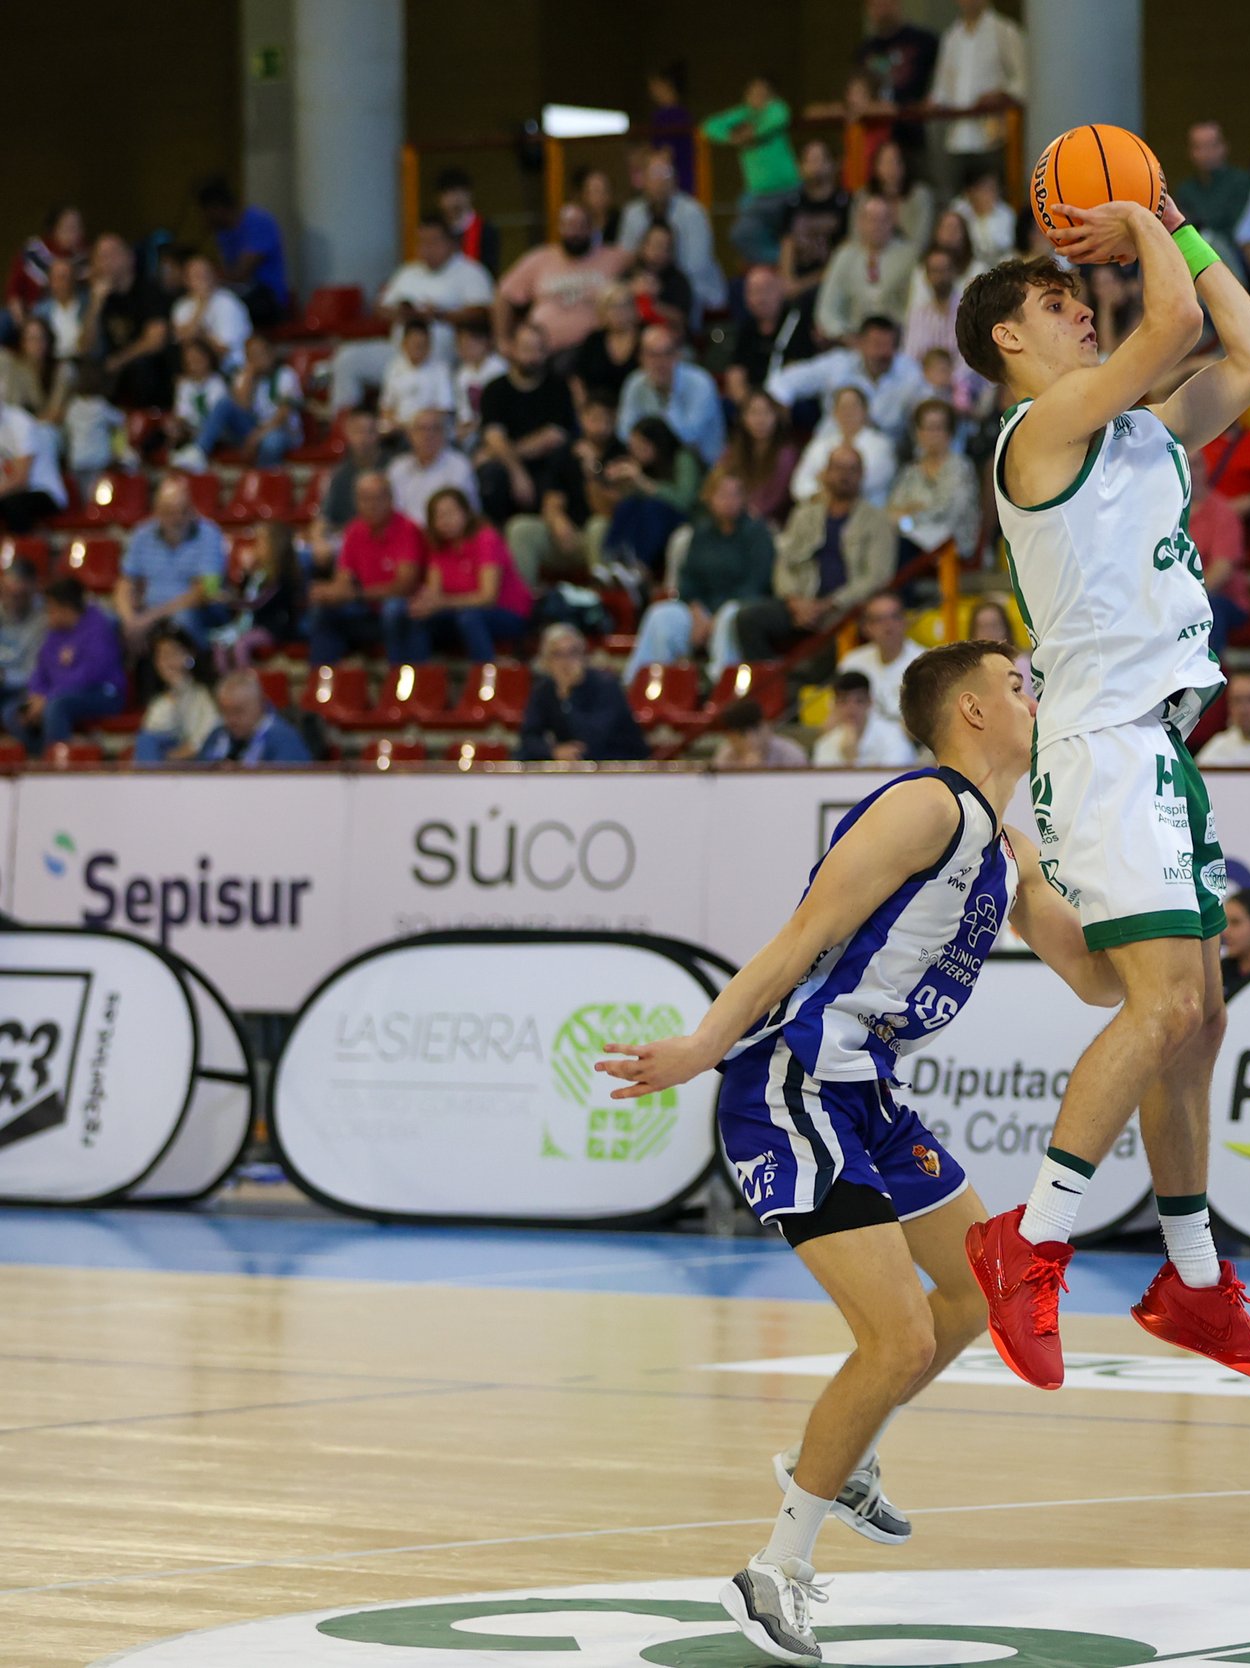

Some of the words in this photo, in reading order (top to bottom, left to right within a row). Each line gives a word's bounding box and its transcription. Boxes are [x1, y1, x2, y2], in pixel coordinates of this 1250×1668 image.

[1154, 800, 1188, 816] Hospit
[82, 852, 312, 944] Sepisur
[914, 984, 959, 1030] 26
[912, 1058, 1072, 1107] Diputac
